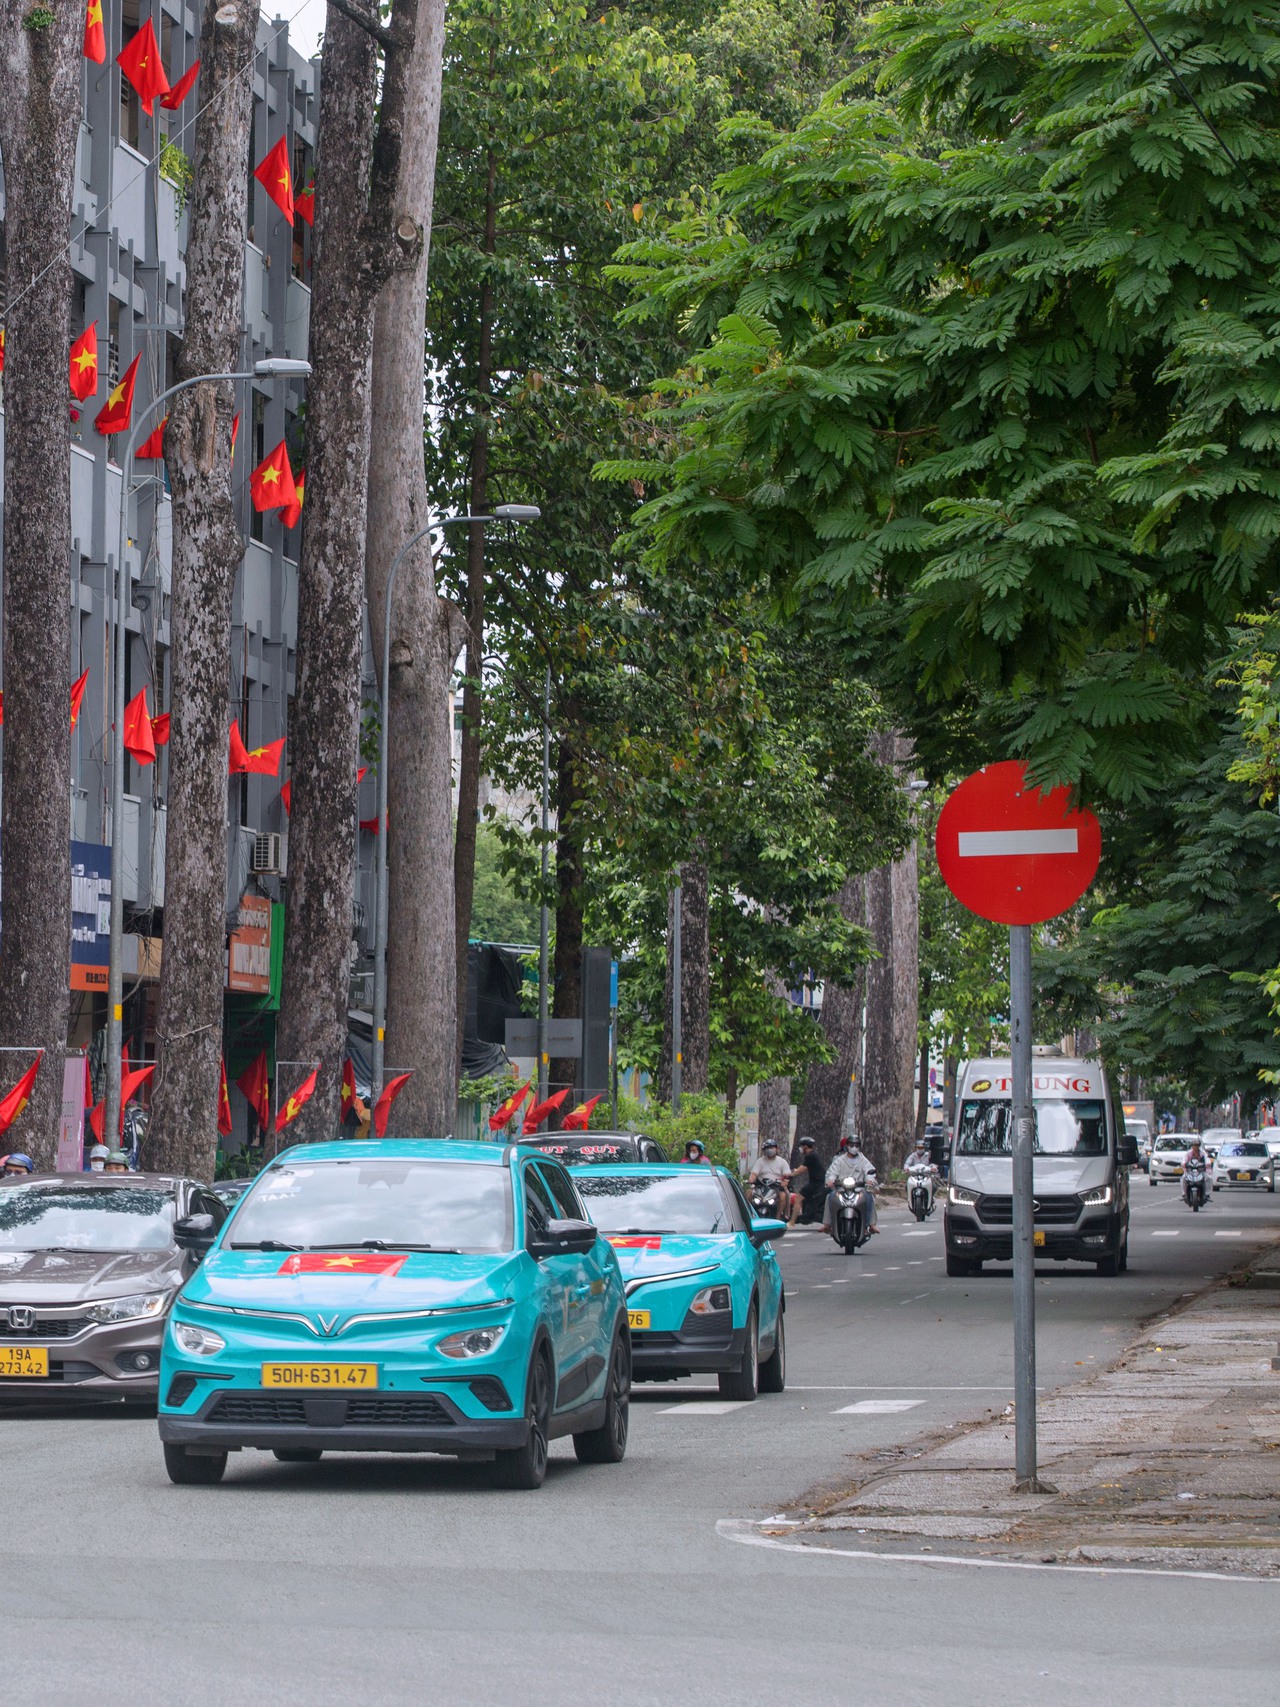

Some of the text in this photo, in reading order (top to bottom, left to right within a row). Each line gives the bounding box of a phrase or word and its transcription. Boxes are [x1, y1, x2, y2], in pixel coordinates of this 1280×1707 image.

[995, 1077, 1091, 1093] TUNG
[535, 1145, 568, 1154] UY
[9, 1348, 32, 1361] 19A
[272, 1368, 368, 1384] 50H-631.47
